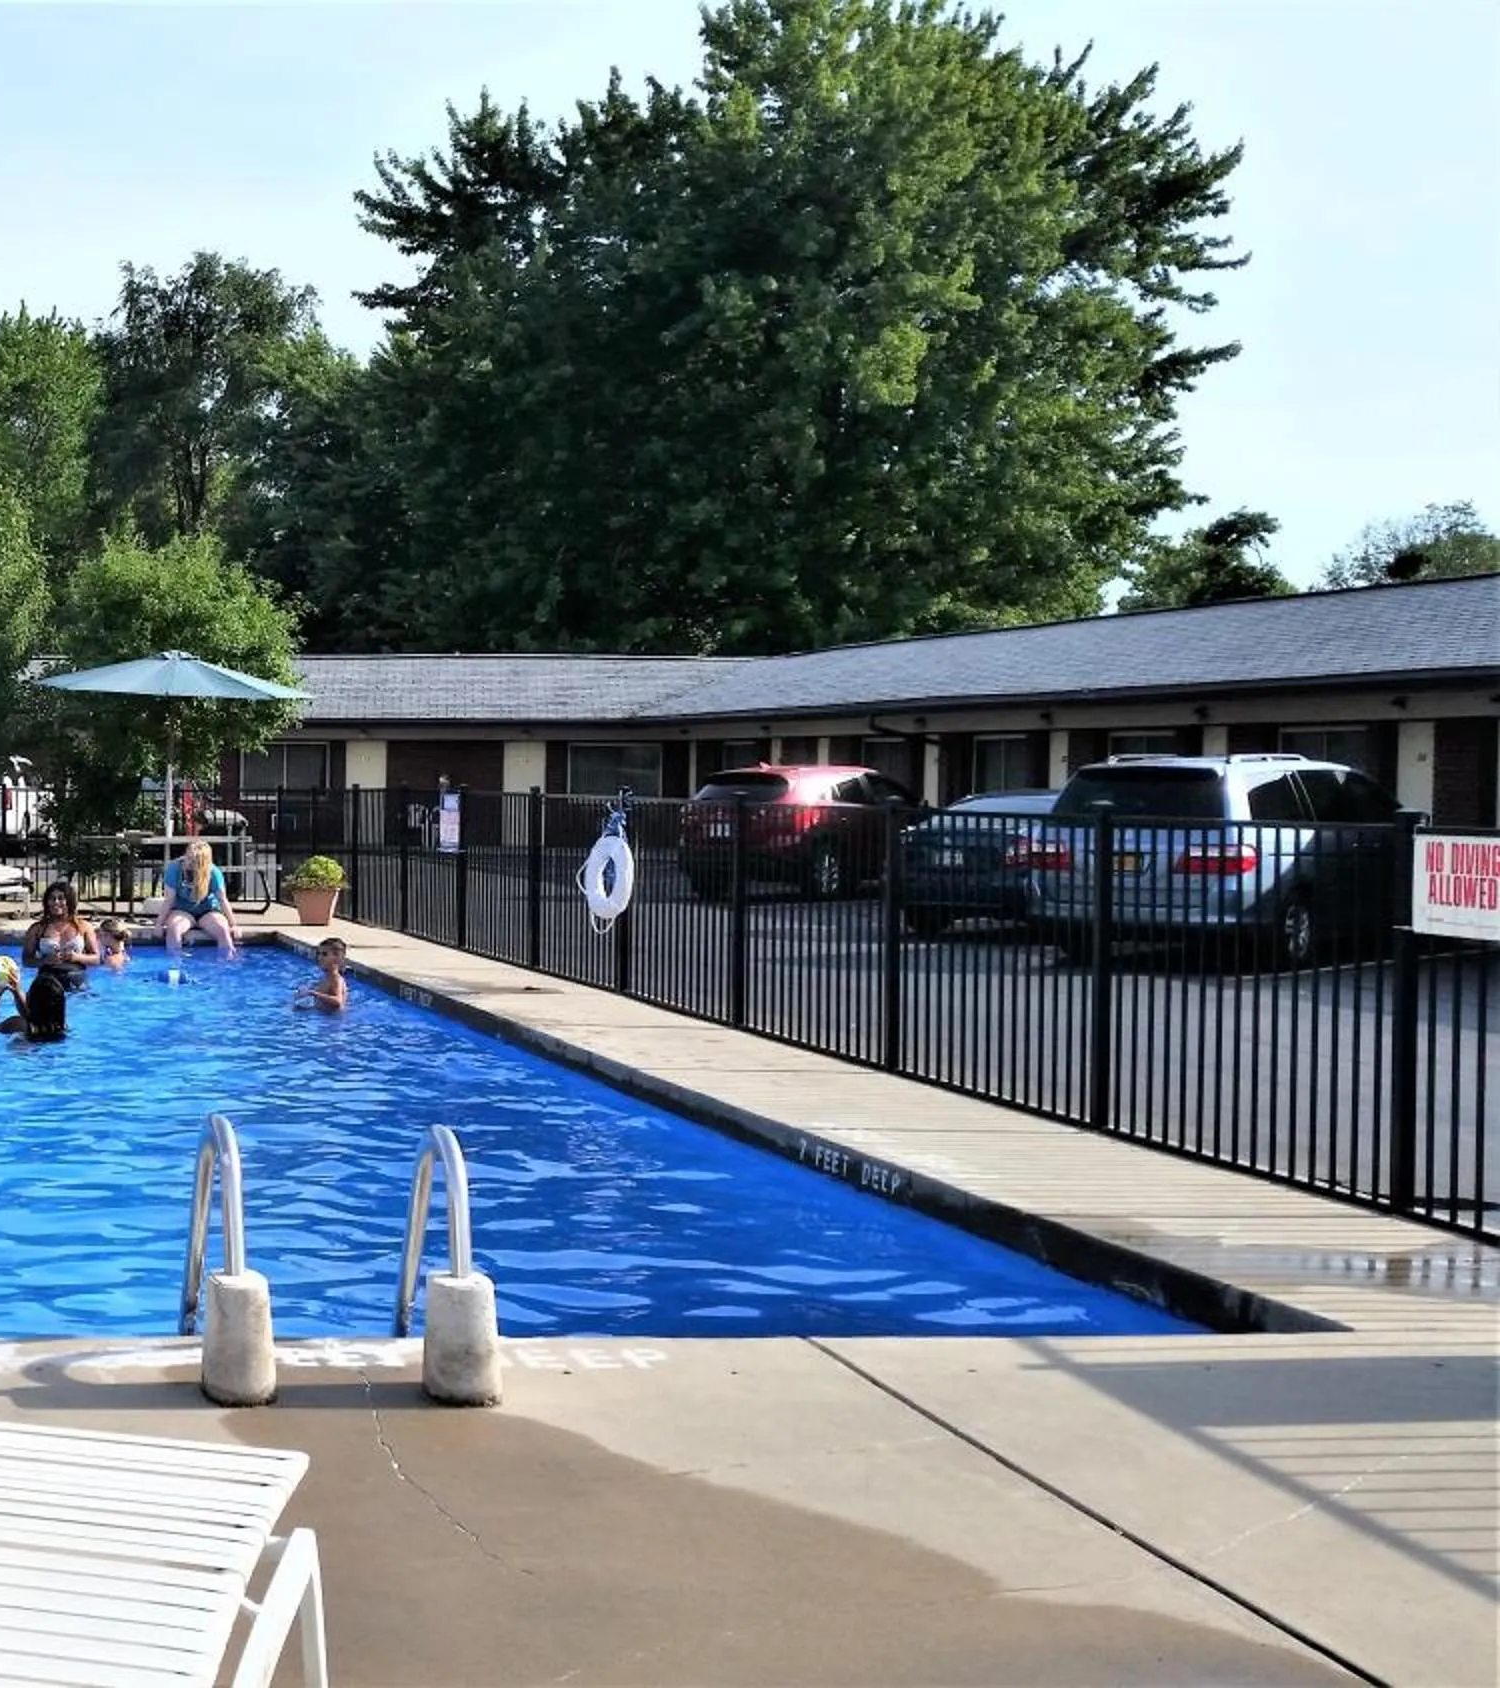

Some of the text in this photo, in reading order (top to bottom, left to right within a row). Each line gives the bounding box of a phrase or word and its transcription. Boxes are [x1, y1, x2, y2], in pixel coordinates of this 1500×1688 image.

[1426, 841, 1500, 877] NO DIVING
[1428, 874, 1498, 911] ALLOWED
[815, 1145, 850, 1177] FEET
[861, 1161, 901, 1195] DEEP
